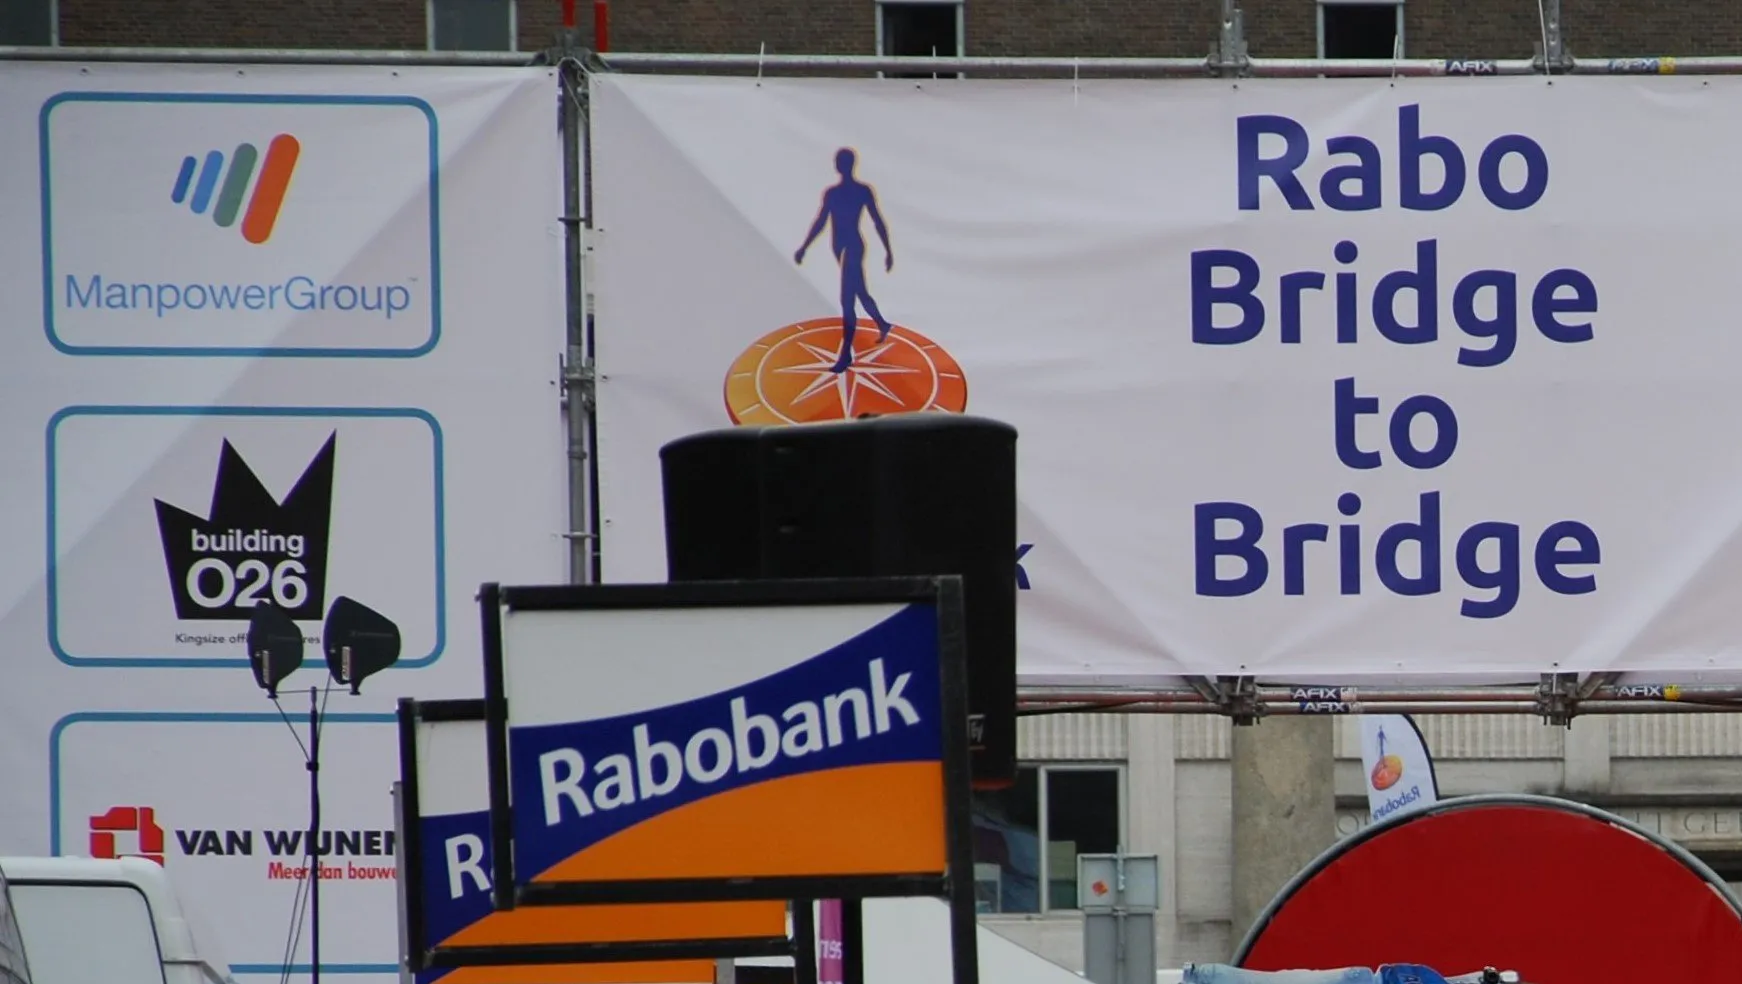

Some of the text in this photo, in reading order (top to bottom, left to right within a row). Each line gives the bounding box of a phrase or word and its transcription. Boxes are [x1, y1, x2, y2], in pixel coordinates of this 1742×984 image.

[1449, 60, 1494, 73] AFIX
[1236, 103, 1549, 211] Rabo
[1190, 238, 1599, 367] Bridge
[1334, 376, 1458, 470] to
[191, 529, 304, 558] building
[1194, 490, 1602, 619] Bridge
[1294, 687, 1338, 700] AFIX
[1617, 685, 1661, 698] AFIX
[538, 657, 920, 827] Rabobank
[175, 830, 252, 856] VAN
[445, 832, 494, 901] R
